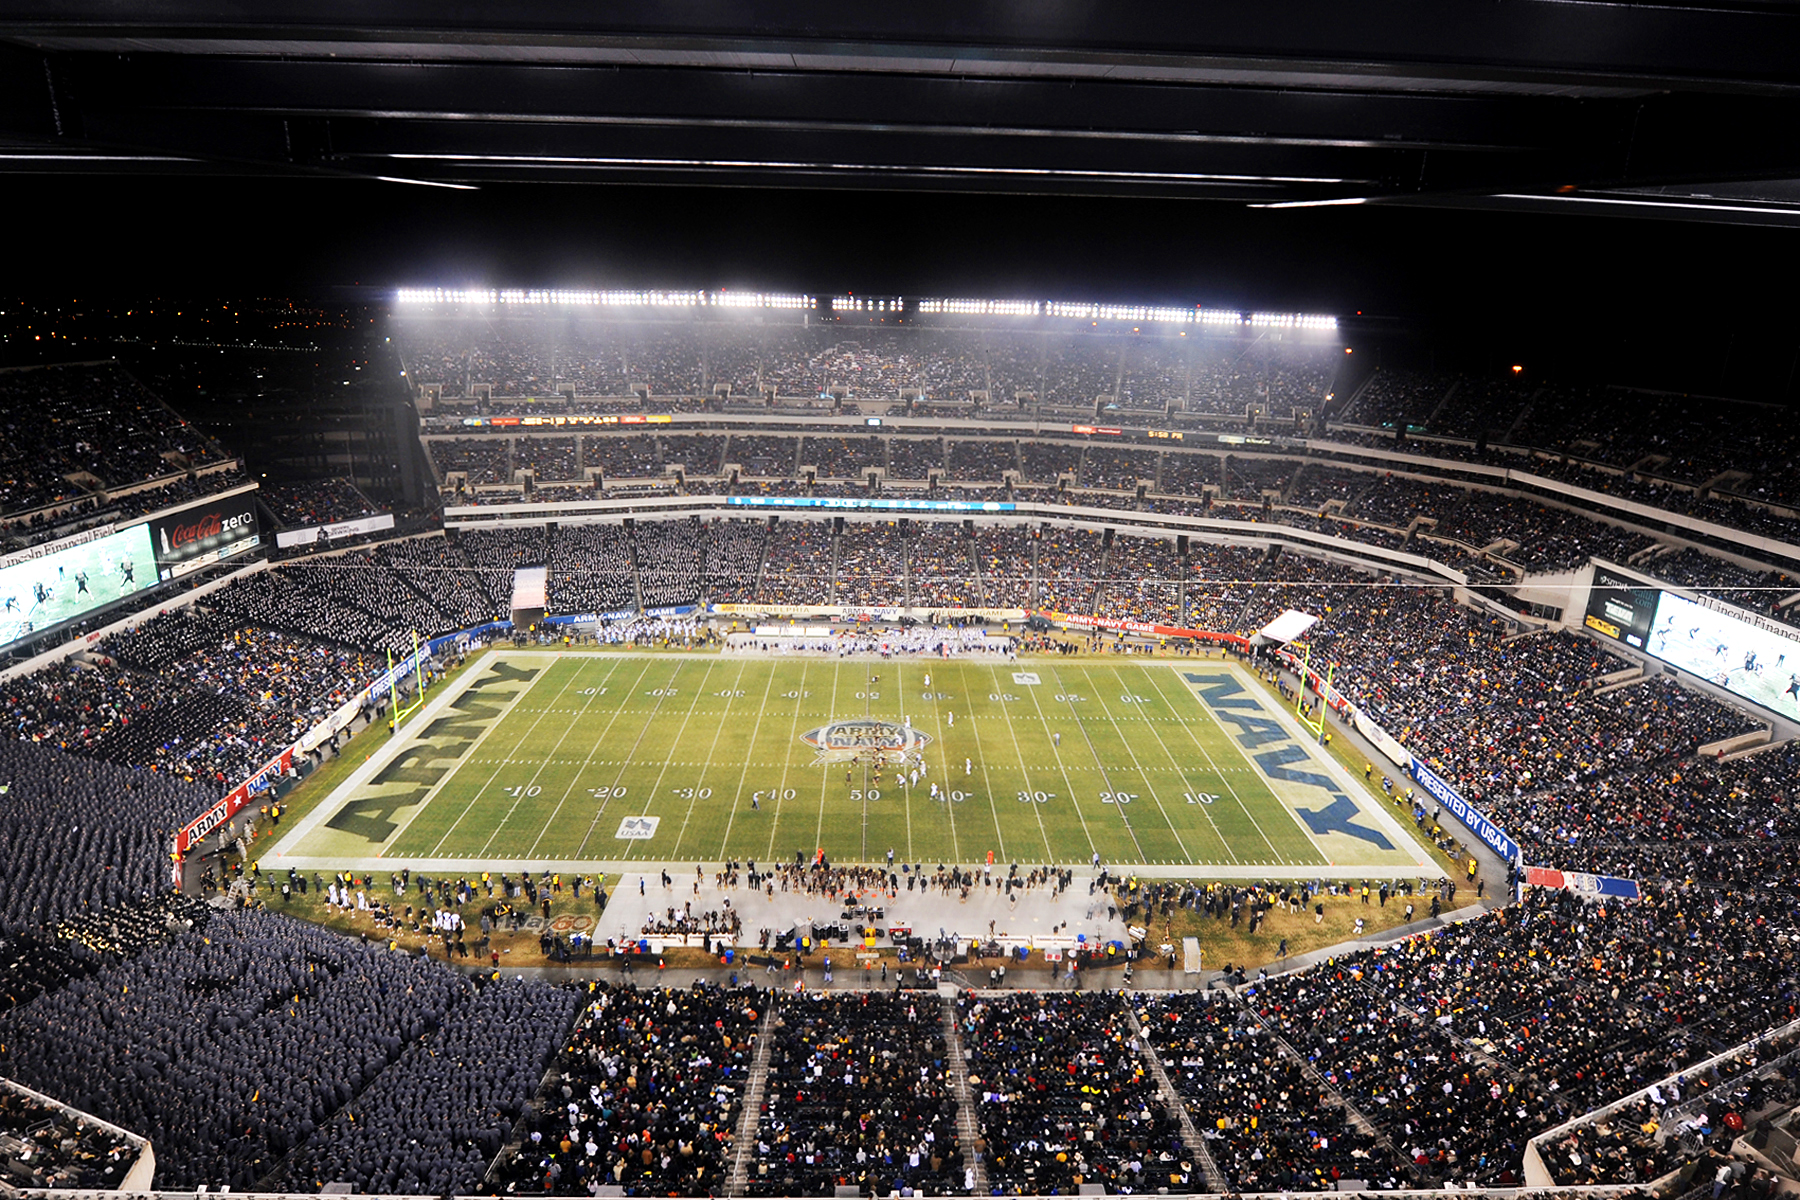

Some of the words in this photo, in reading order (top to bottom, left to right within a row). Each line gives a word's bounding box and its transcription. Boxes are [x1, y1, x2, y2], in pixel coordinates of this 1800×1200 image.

[221, 512, 253, 532] zero
[43, 531, 93, 556] Financial
[93, 522, 117, 540] Field
[647, 608, 676, 617] GAME
[1708, 599, 1752, 624] Lincoln
[1066, 614, 1123, 629] ARMY-NAVY
[1125, 622, 1155, 632] GAME
[833, 737, 898, 746] NAVY
[834, 727, 898, 735] ARMY
[325, 662, 541, 843] ARMY
[1183, 673, 1397, 850] NAVY
[850, 789, 881, 801] 50
[188, 801, 228, 844] ARMY
[1416, 767, 1466, 818] PRESENTED
[1466, 810, 1481, 830] BY
[1480, 822, 1508, 857] USAA
